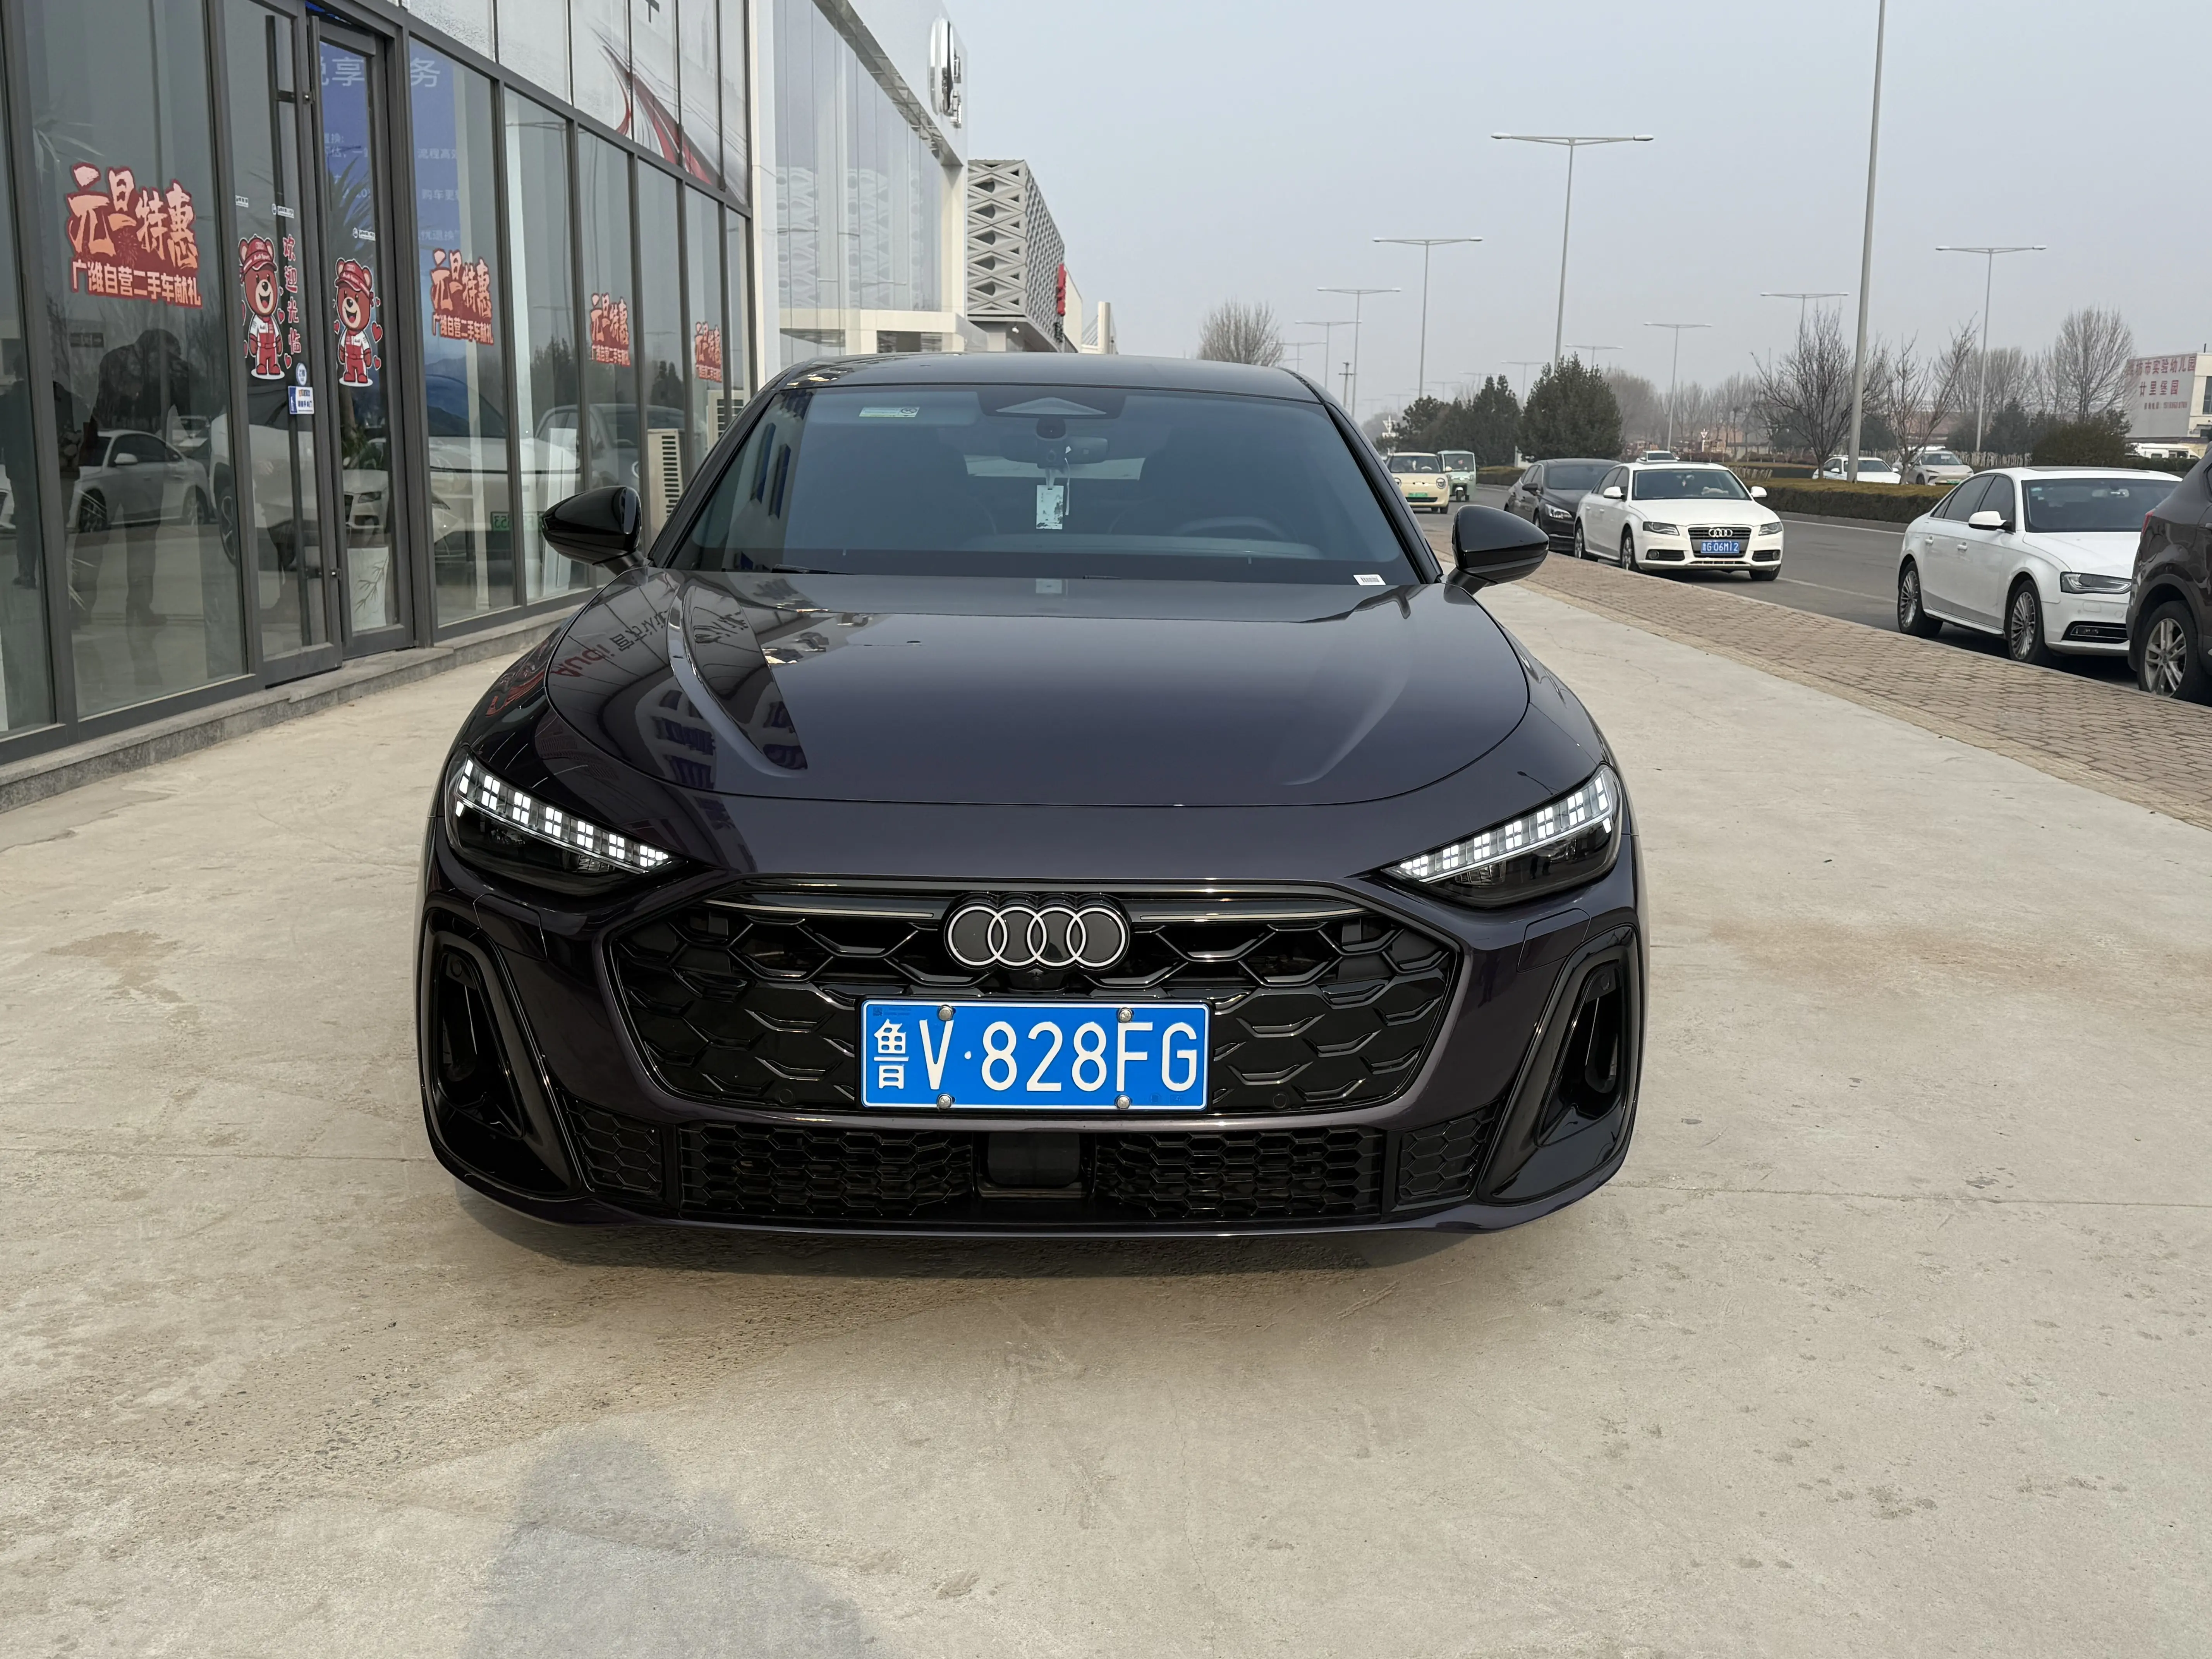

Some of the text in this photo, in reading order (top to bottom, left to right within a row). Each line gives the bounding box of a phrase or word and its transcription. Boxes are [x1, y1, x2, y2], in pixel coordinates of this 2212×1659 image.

[410, 57, 440, 88] 务
[68, 166, 199, 270] 元旦特惠
[72, 259, 201, 306] 广潍自营二手车献礼
[283, 234, 301, 354] 欢迎光临
[874, 1018, 1197, 1092] 鲁V·828FG
